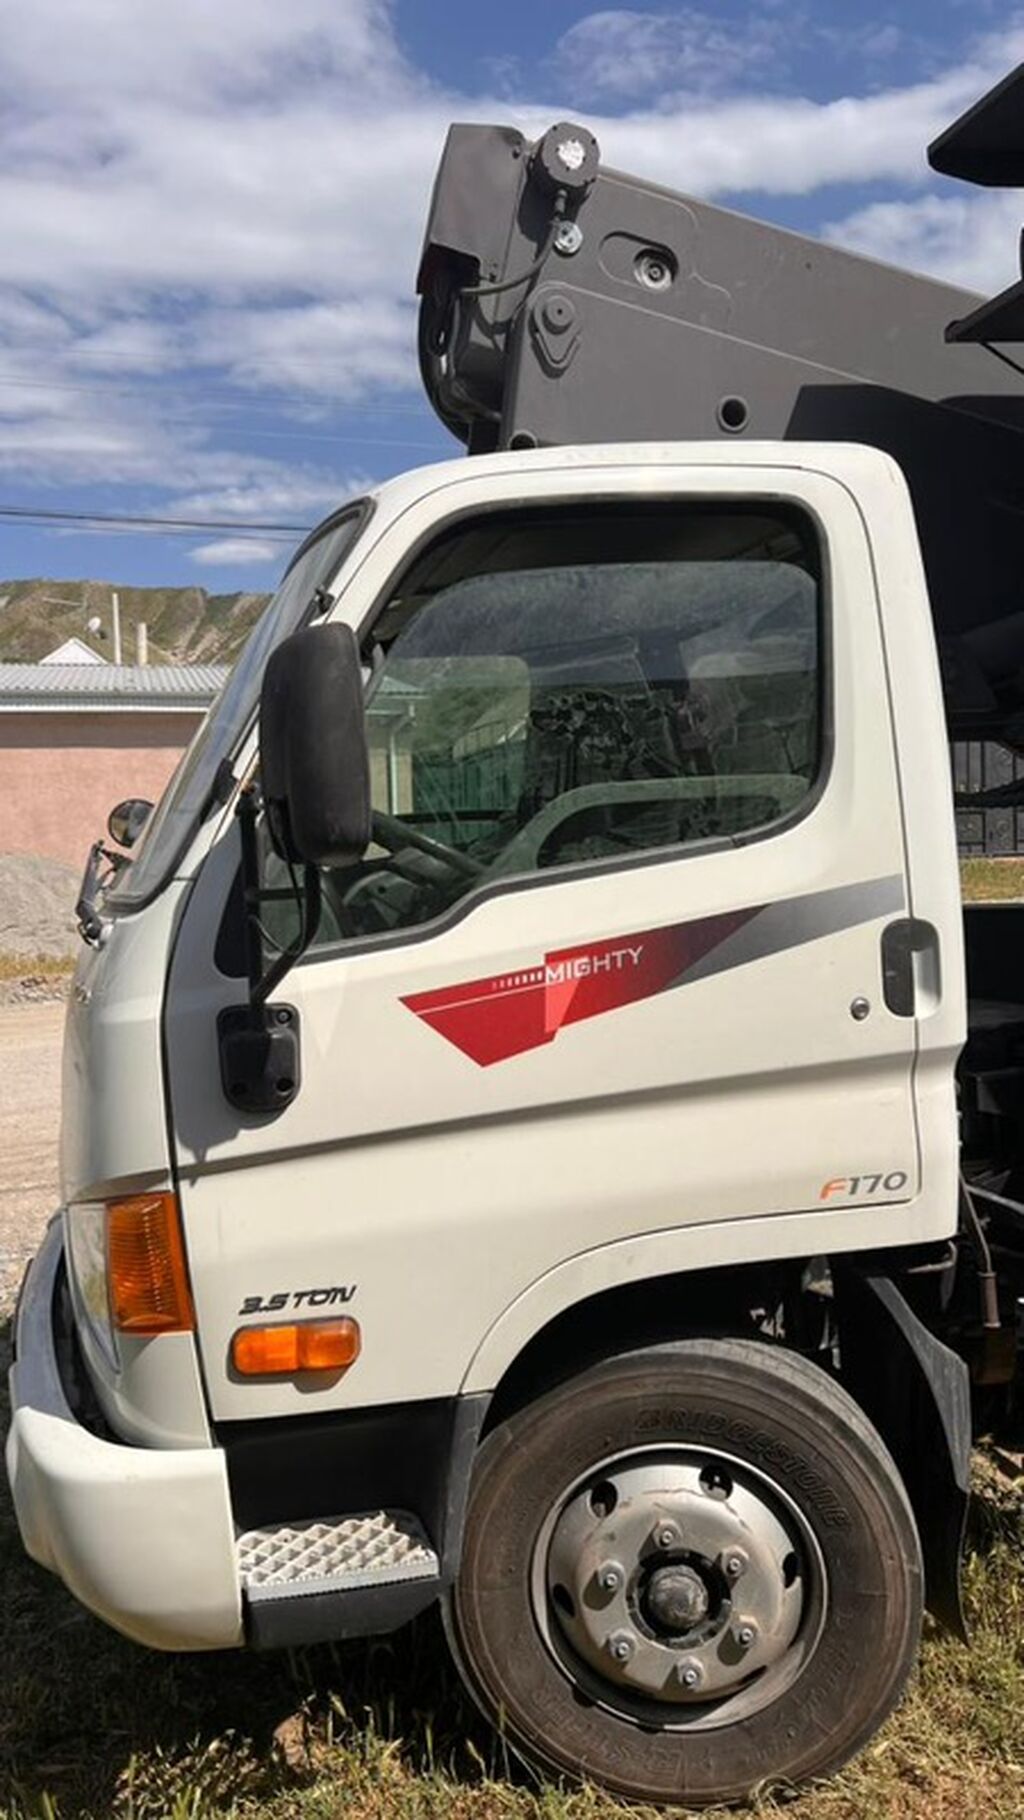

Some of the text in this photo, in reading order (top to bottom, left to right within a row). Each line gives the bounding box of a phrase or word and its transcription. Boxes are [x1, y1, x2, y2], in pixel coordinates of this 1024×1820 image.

[545, 945, 643, 984] MIGHTY
[820, 1171, 908, 1201] F170
[238, 1284, 358, 1315] 3.5 TON
